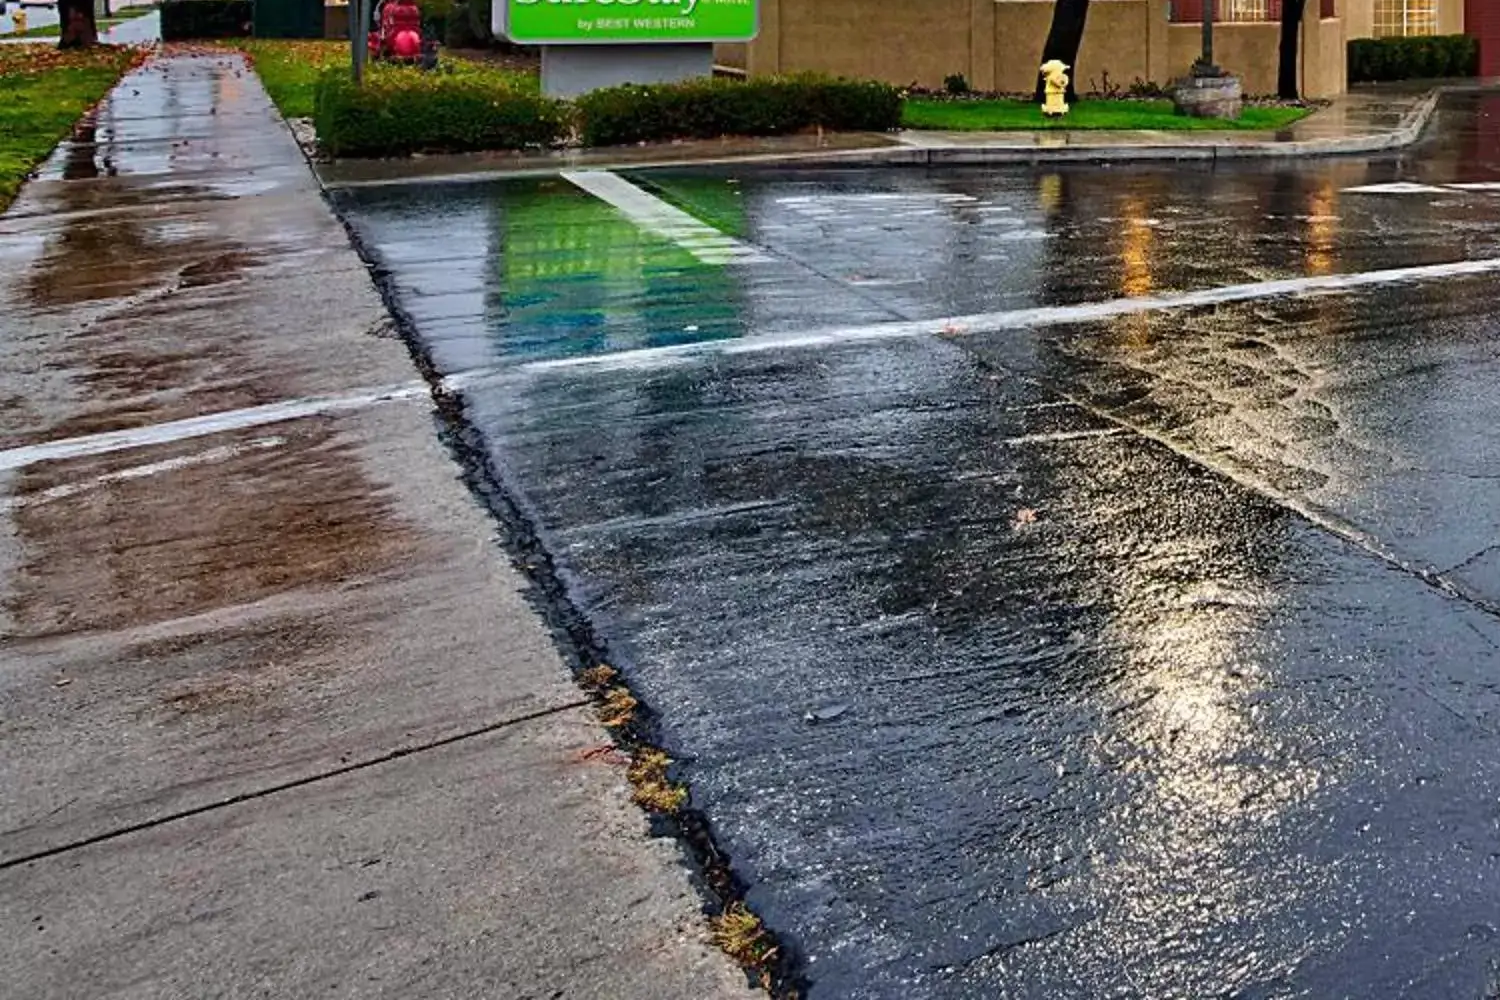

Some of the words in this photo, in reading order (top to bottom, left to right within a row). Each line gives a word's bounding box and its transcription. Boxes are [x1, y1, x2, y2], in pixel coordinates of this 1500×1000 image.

[577, 18, 593, 31] by
[596, 18, 630, 29] BEST
[633, 18, 696, 29] WESTERN
